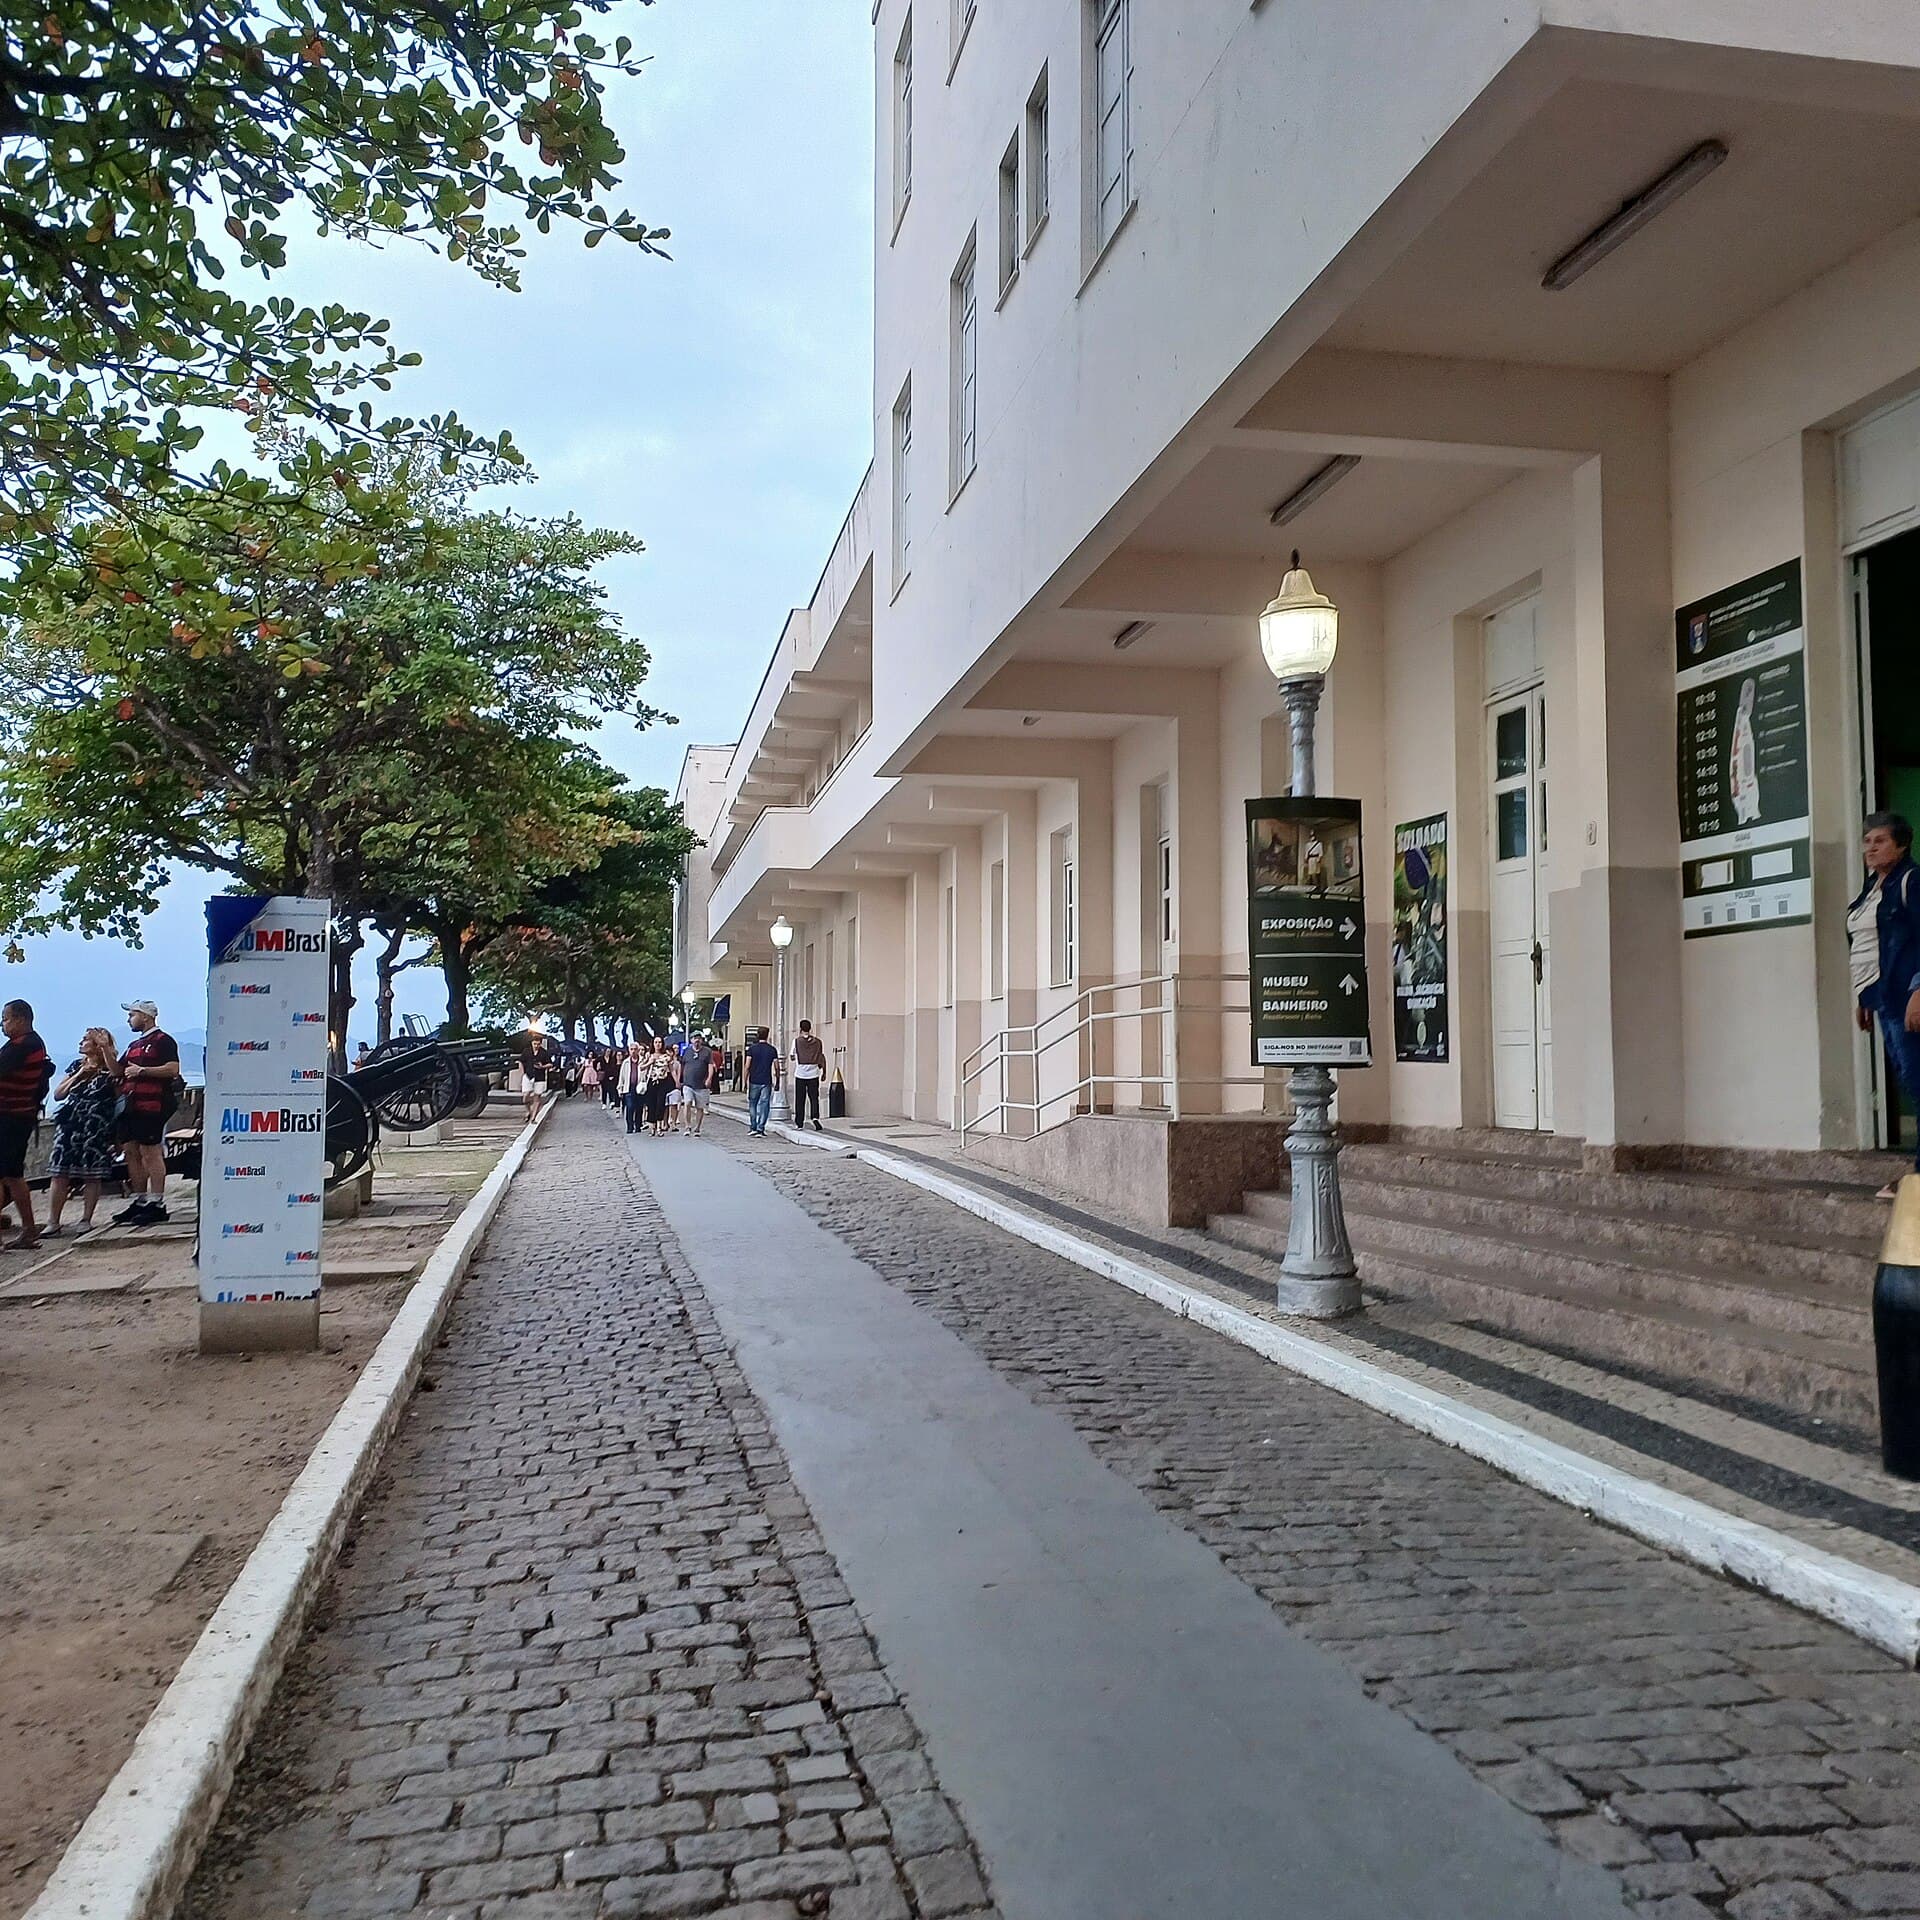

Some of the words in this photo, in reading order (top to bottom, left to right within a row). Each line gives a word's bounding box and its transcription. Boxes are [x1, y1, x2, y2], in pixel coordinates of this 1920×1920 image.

[1261, 916, 1334, 931] EXPOSIÇÃO
[1262, 976, 1309, 987] MUSEU
[1262, 1000, 1329, 1011] BANHEIRO
[224, 1166, 266, 1176] AluMBrasil
